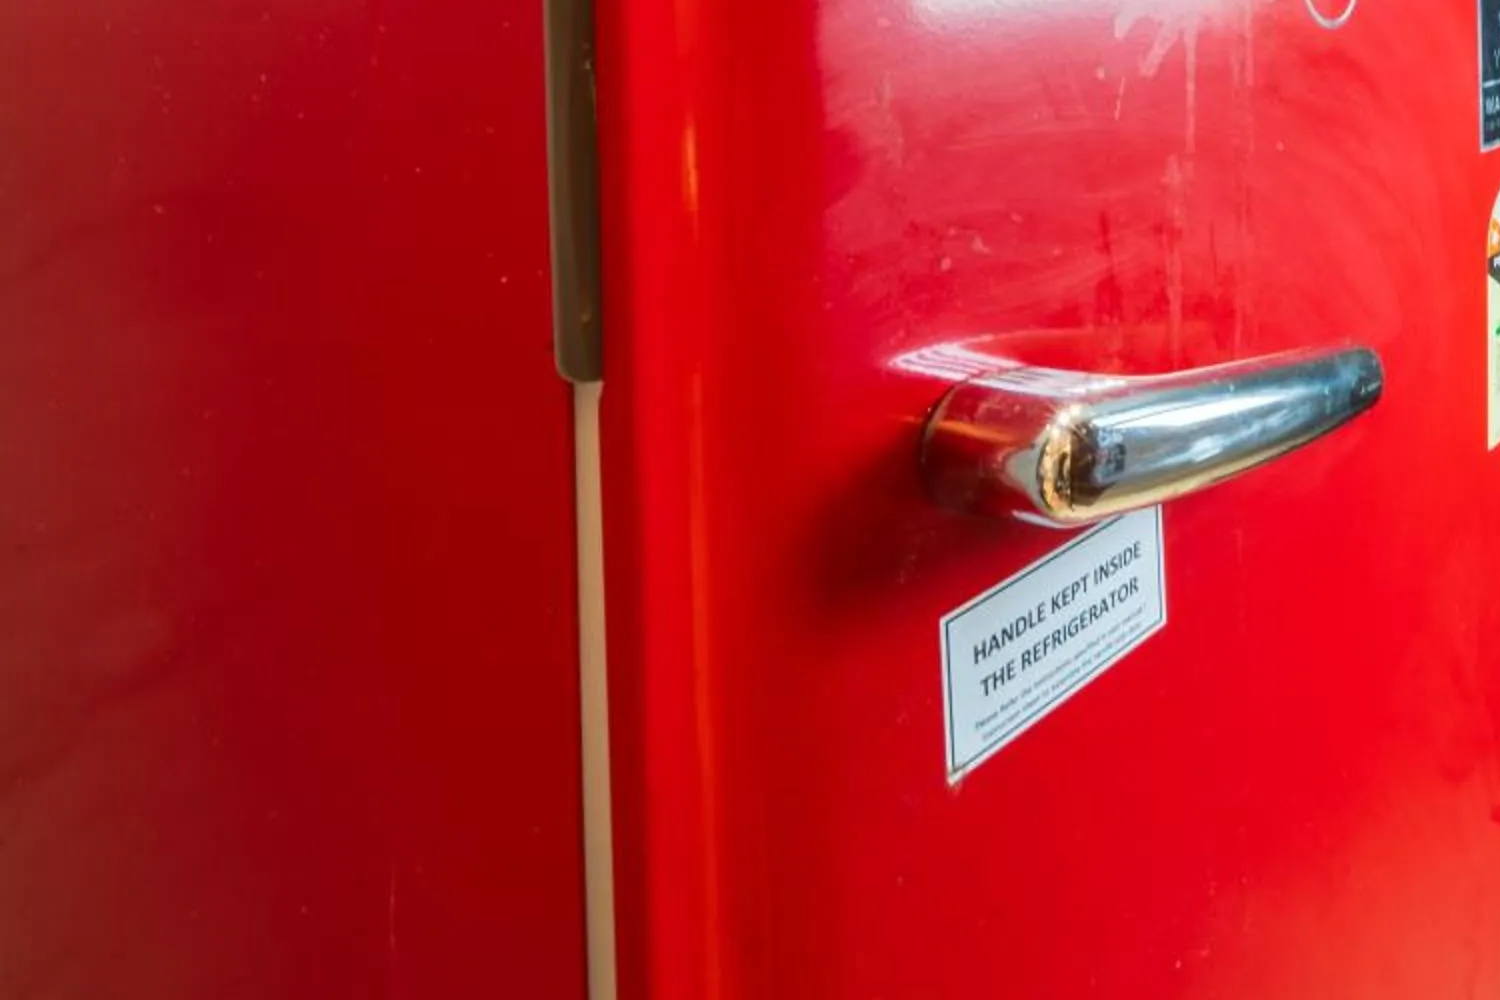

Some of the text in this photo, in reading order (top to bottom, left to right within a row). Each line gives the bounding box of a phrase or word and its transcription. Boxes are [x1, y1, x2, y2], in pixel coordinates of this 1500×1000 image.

[973, 541, 1142, 665] HANDLE KEPT INSIDE
[980, 660, 1016, 697] THE
[1021, 576, 1139, 672] REFRIGERATOR
